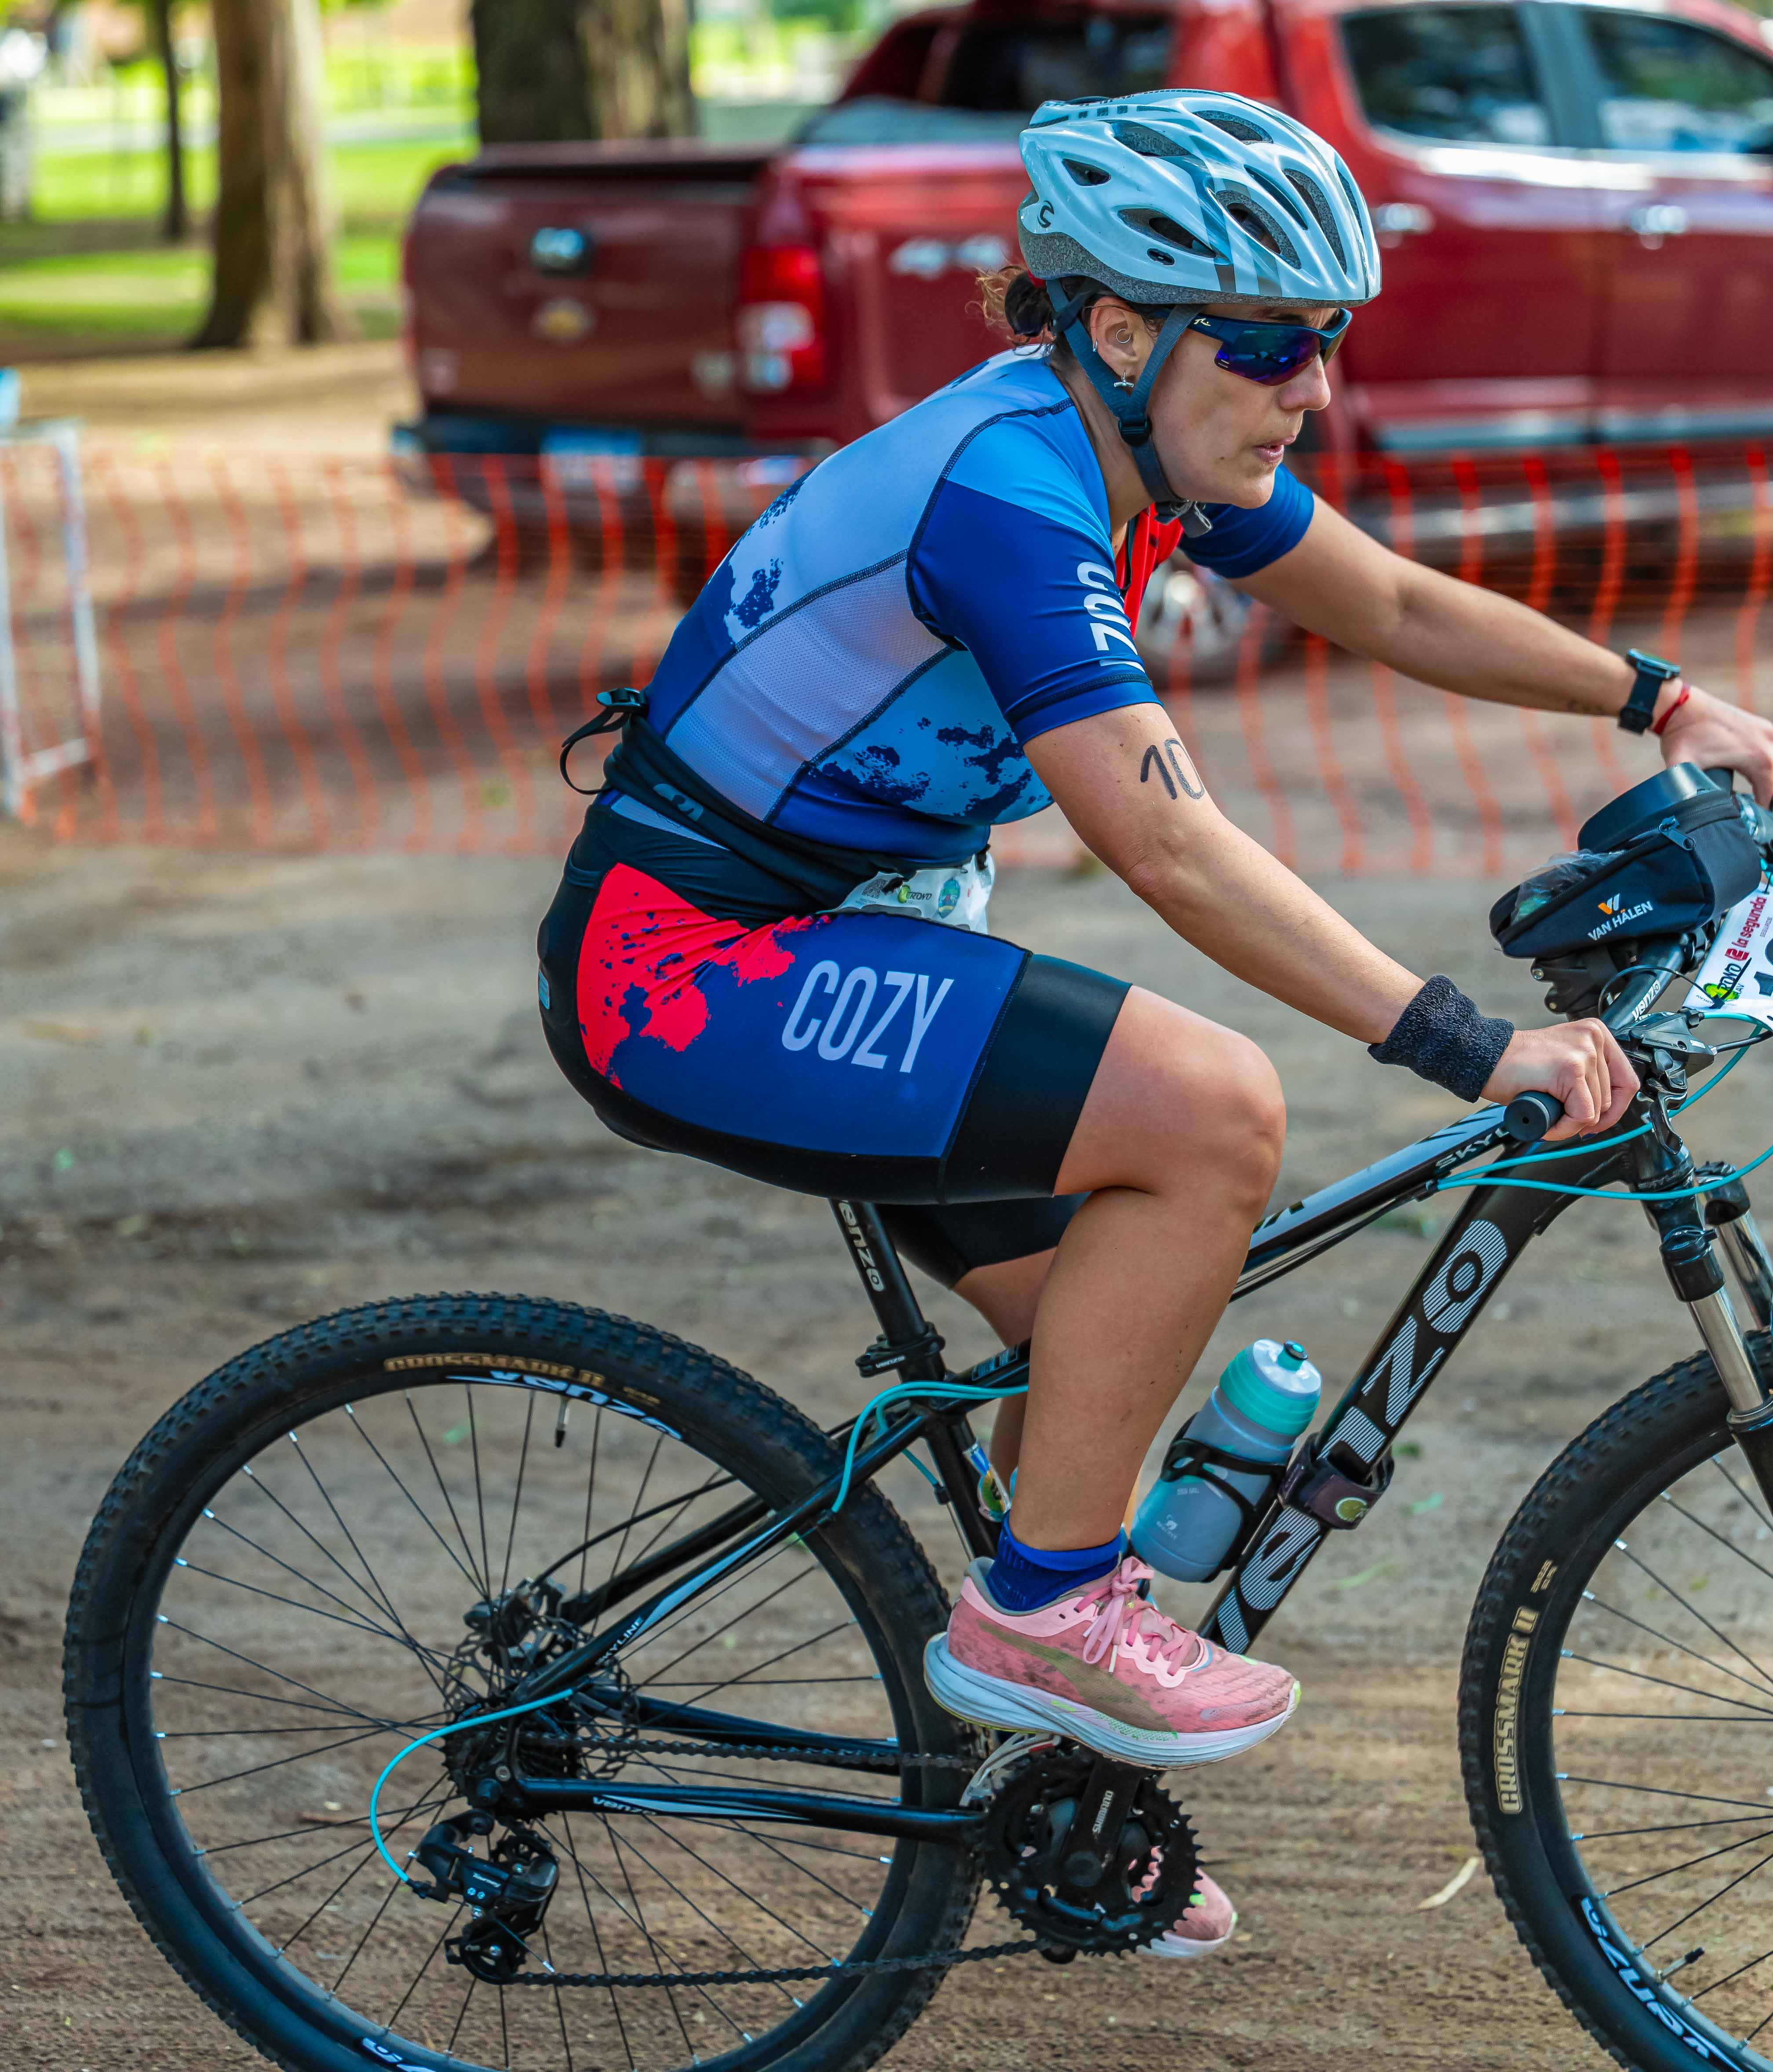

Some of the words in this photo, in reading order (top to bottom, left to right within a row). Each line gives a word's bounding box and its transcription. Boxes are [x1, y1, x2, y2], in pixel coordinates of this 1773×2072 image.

[1587, 920, 1612, 941] VAN
[1740, 896, 1767, 938] segunda
[781, 959, 954, 1073] COZY
[838, 1201, 886, 1292] enzo
[490, 1370, 682, 1440] venzo
[595, 1616, 643, 1665] SKYLINE
[1494, 1633, 1530, 1815] CROSSMARK
[1512, 1606, 1540, 1634] II
[1580, 1897, 1710, 2059] venzo
